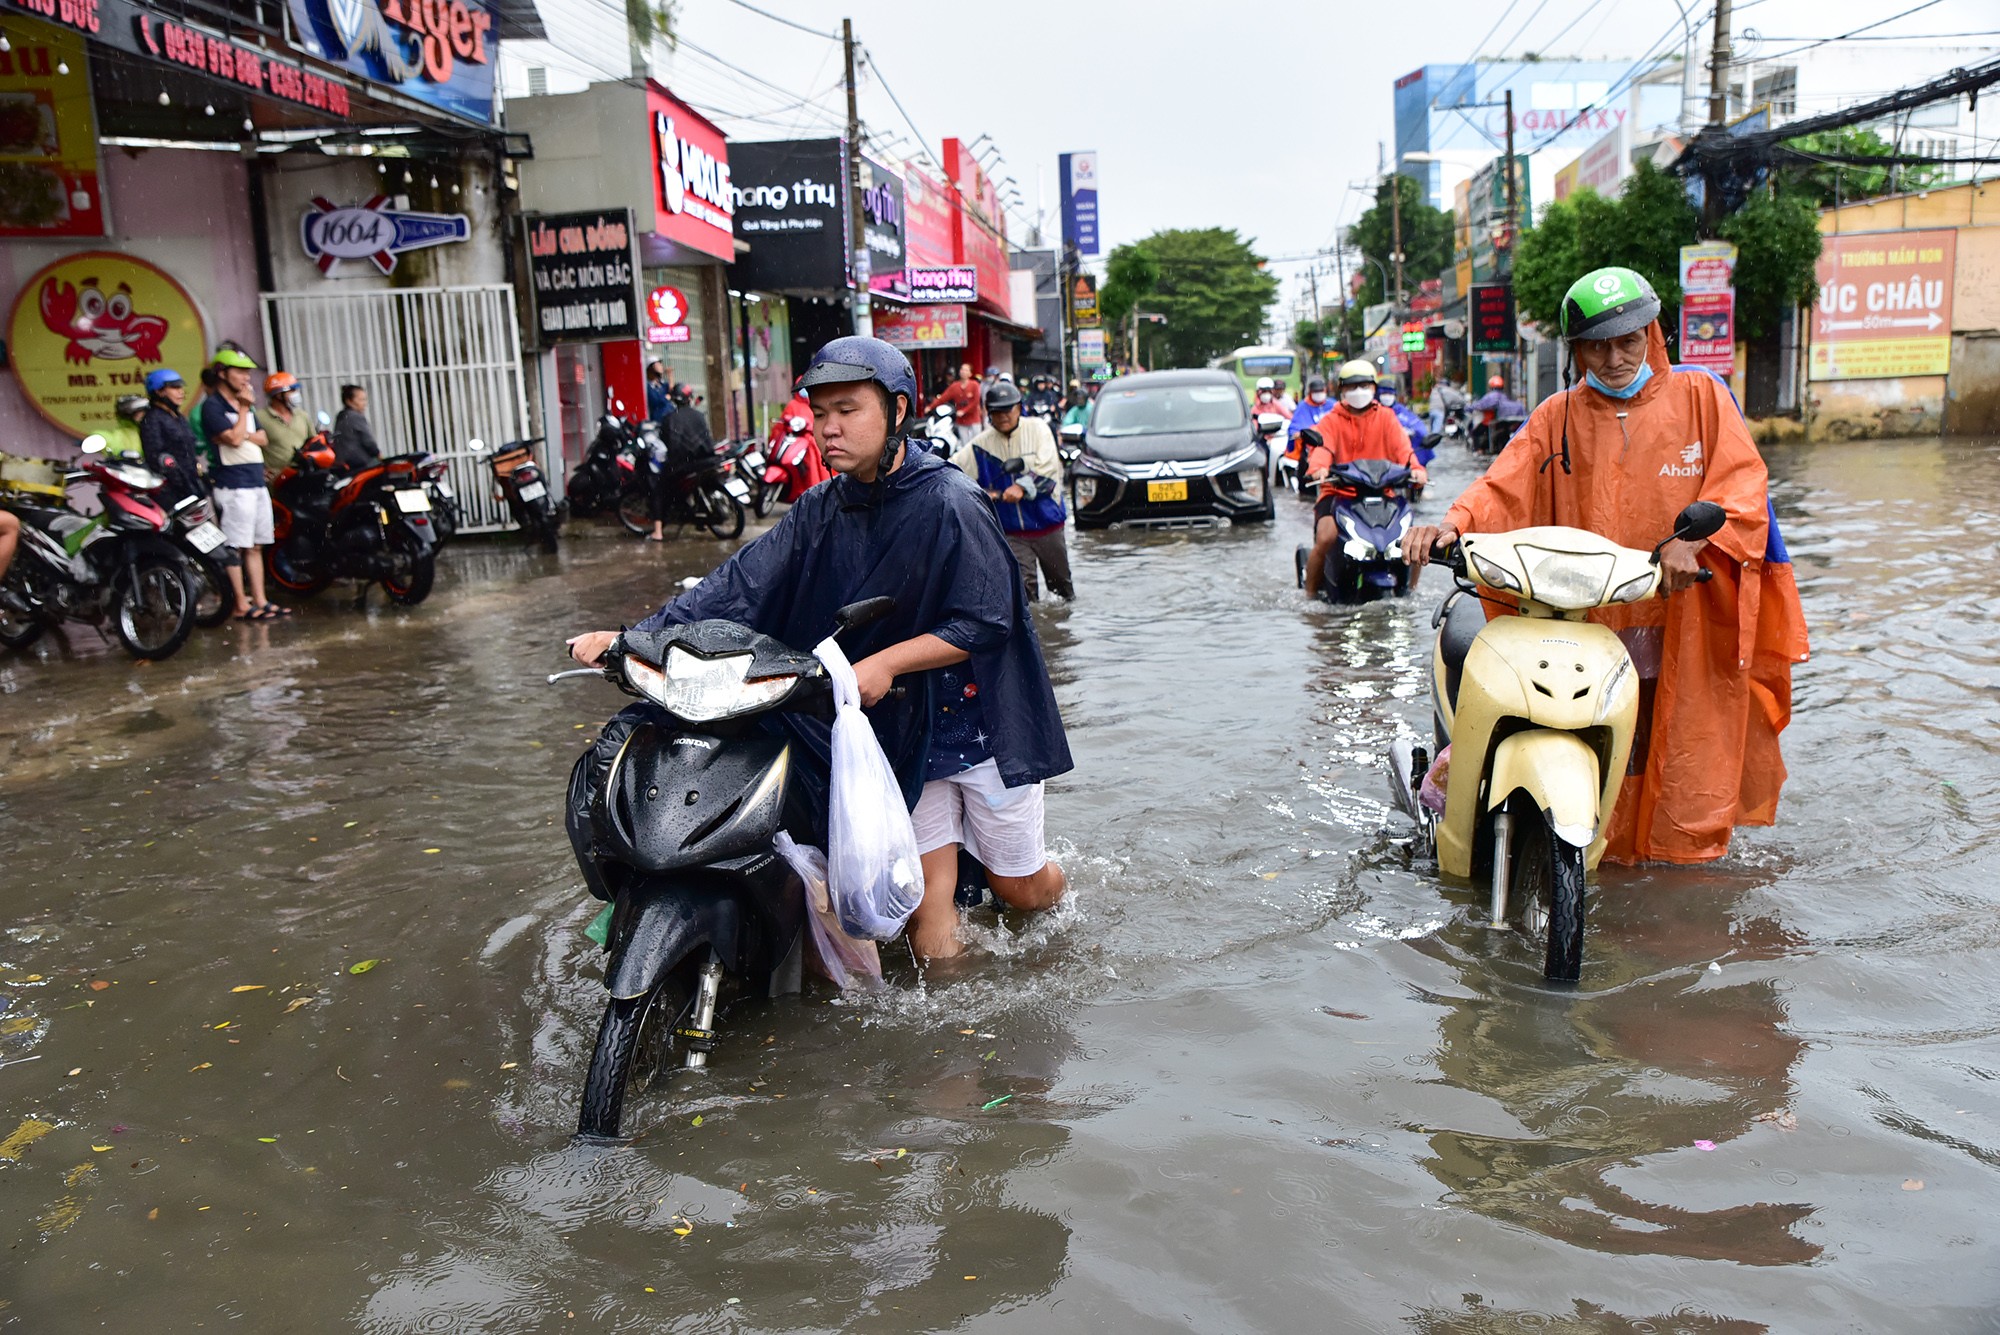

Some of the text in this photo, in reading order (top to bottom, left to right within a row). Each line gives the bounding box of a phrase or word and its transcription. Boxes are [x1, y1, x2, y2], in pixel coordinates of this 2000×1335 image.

[1522, 109, 1628, 130] GALAXY
[681, 137, 734, 214] MIXUE
[792, 178, 836, 208] tiny
[311, 206, 382, 246] 1664
[534, 264, 552, 291] VÀ
[552, 262, 577, 291] CÁC
[577, 260, 605, 288] MÓN
[1819, 273, 1944, 315] ÚC CHÂU
[916, 321, 944, 340] GÀ
[1862, 314, 1894, 329] 50m
[68, 367, 149, 387] MR. TUẤ
[80, 412, 117, 421] SINC
[1541, 638, 1583, 648] HONDA
[672, 738, 712, 749] HONDA
[745, 854, 775, 876] HONDA
